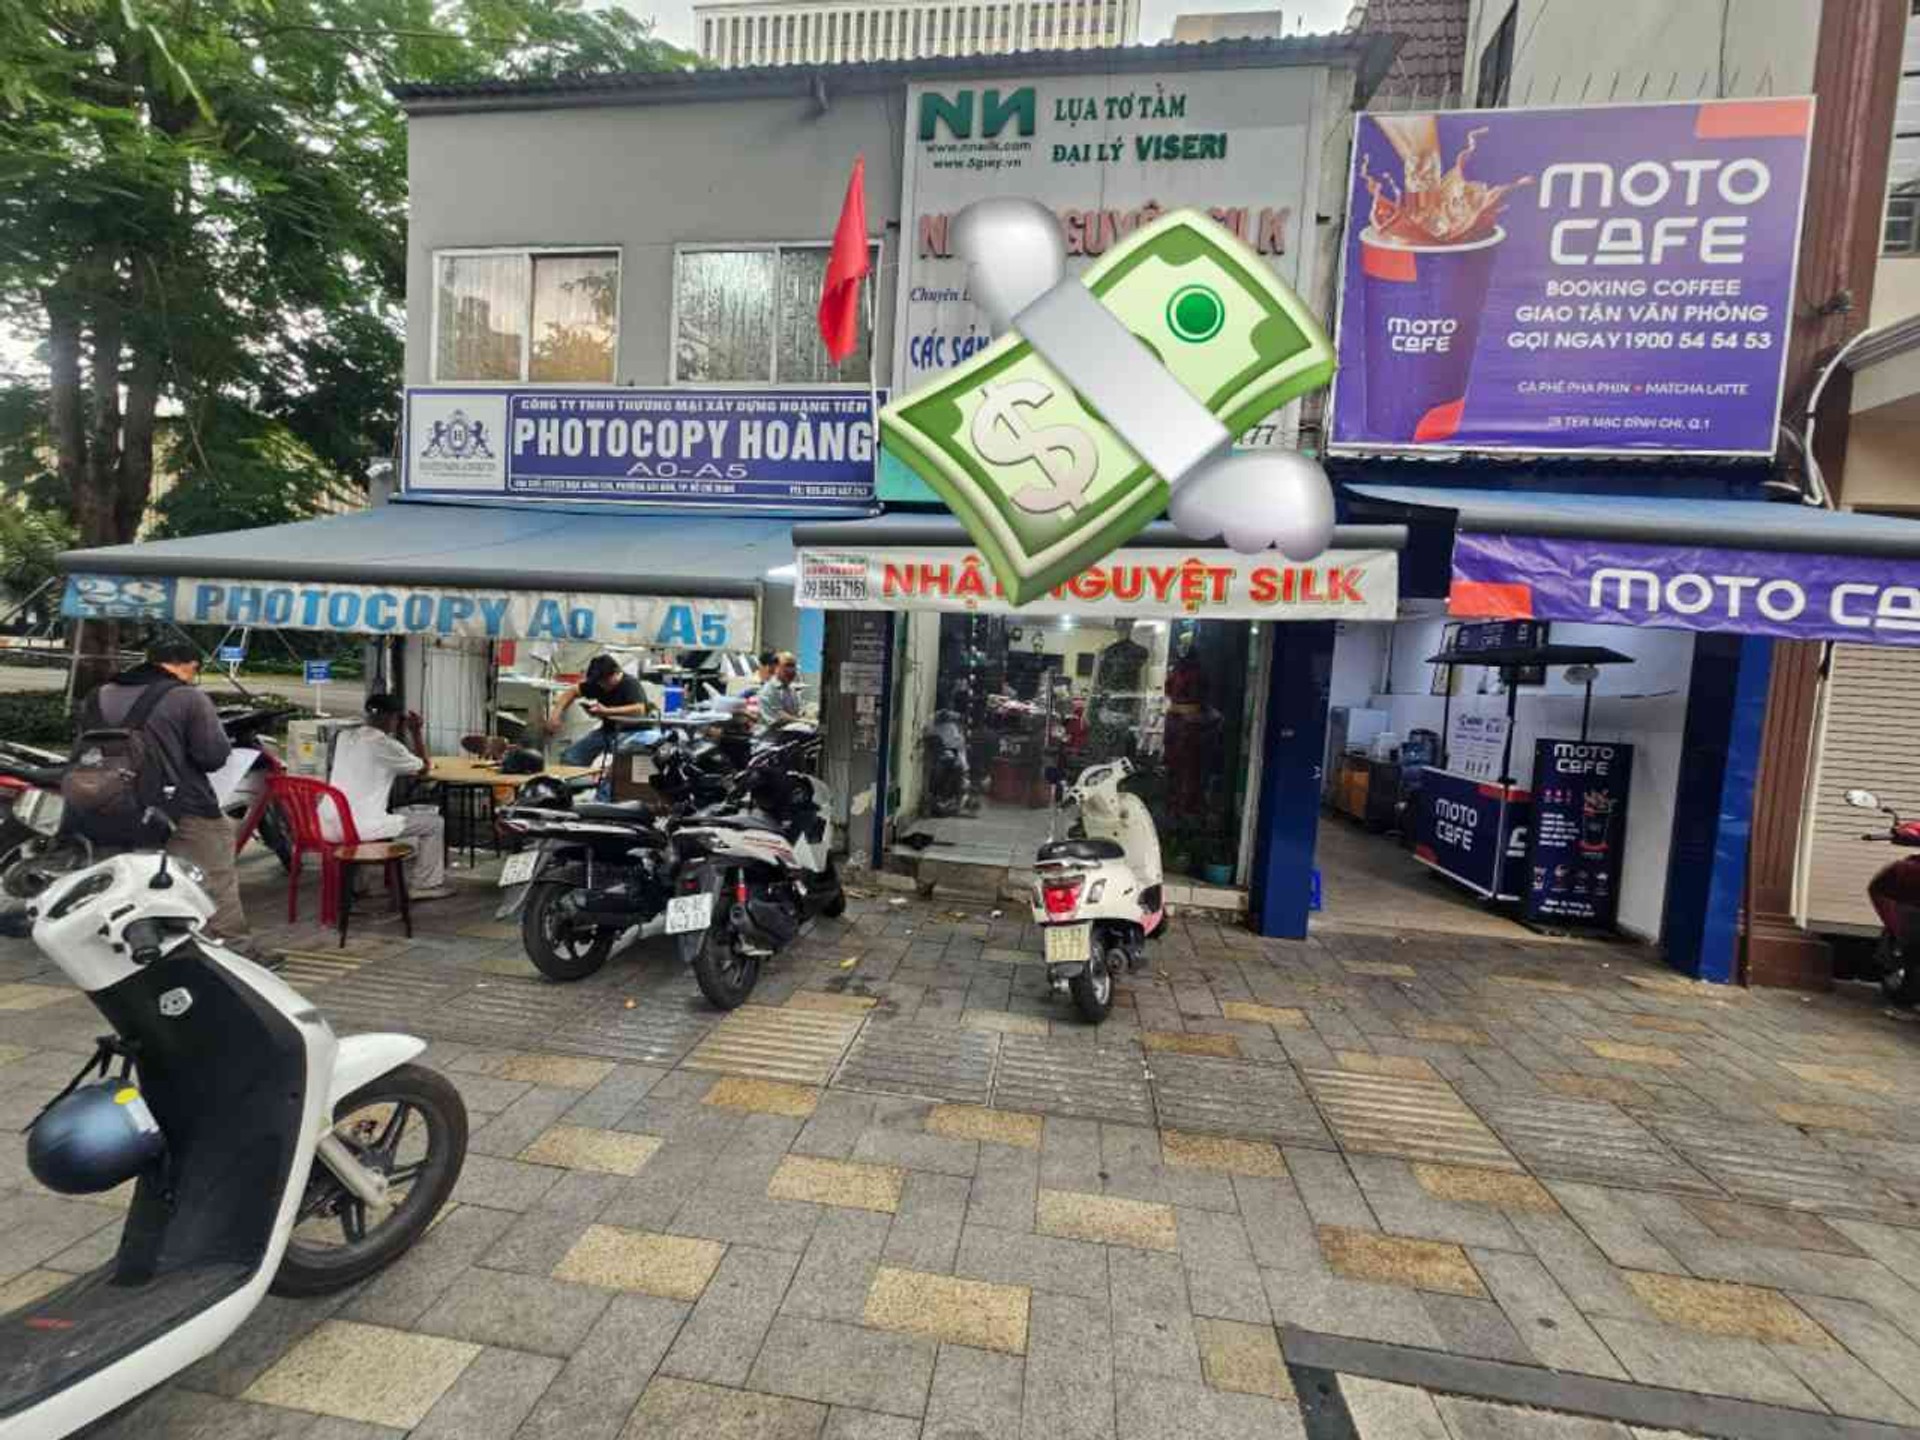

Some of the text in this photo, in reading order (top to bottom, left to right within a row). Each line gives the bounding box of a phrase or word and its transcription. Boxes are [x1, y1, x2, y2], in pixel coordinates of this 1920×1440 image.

[1054, 97, 1098, 127] LỤA
[1052, 132, 1228, 167] ĐẠI LÝ VISERI
[1538, 158, 1771, 210] MOTO
[1549, 216, 1748, 266] CAFE
[1546, 279, 1741, 297] BOOKING COFFEE
[1387, 318, 1457, 336] MOTO
[1515, 304, 1574, 322] GIAO
[1579, 302, 1622, 325] TẬN
[911, 327, 946, 370] CÁC
[1391, 335, 1452, 353] CAFE
[1507, 331, 1773, 352] GỌI NGAY 1900 54 54 53
[1646, 384, 1705, 396] MATCHA
[1706, 384, 1750, 396] LATTE
[513, 412, 873, 462] PHOTOCOPY HOÀNG
[1249, 567, 1366, 605] SILK
[1590, 568, 1807, 622] MOTO
[195, 583, 510, 636] PHOTOCOPY
[655, 604, 729, 648] A5
[1554, 744, 1615, 760] MOTO
[1556, 758, 1610, 776] CAFE
[1435, 798, 1478, 828] MOTO
[1435, 820, 1475, 852] CAFE
